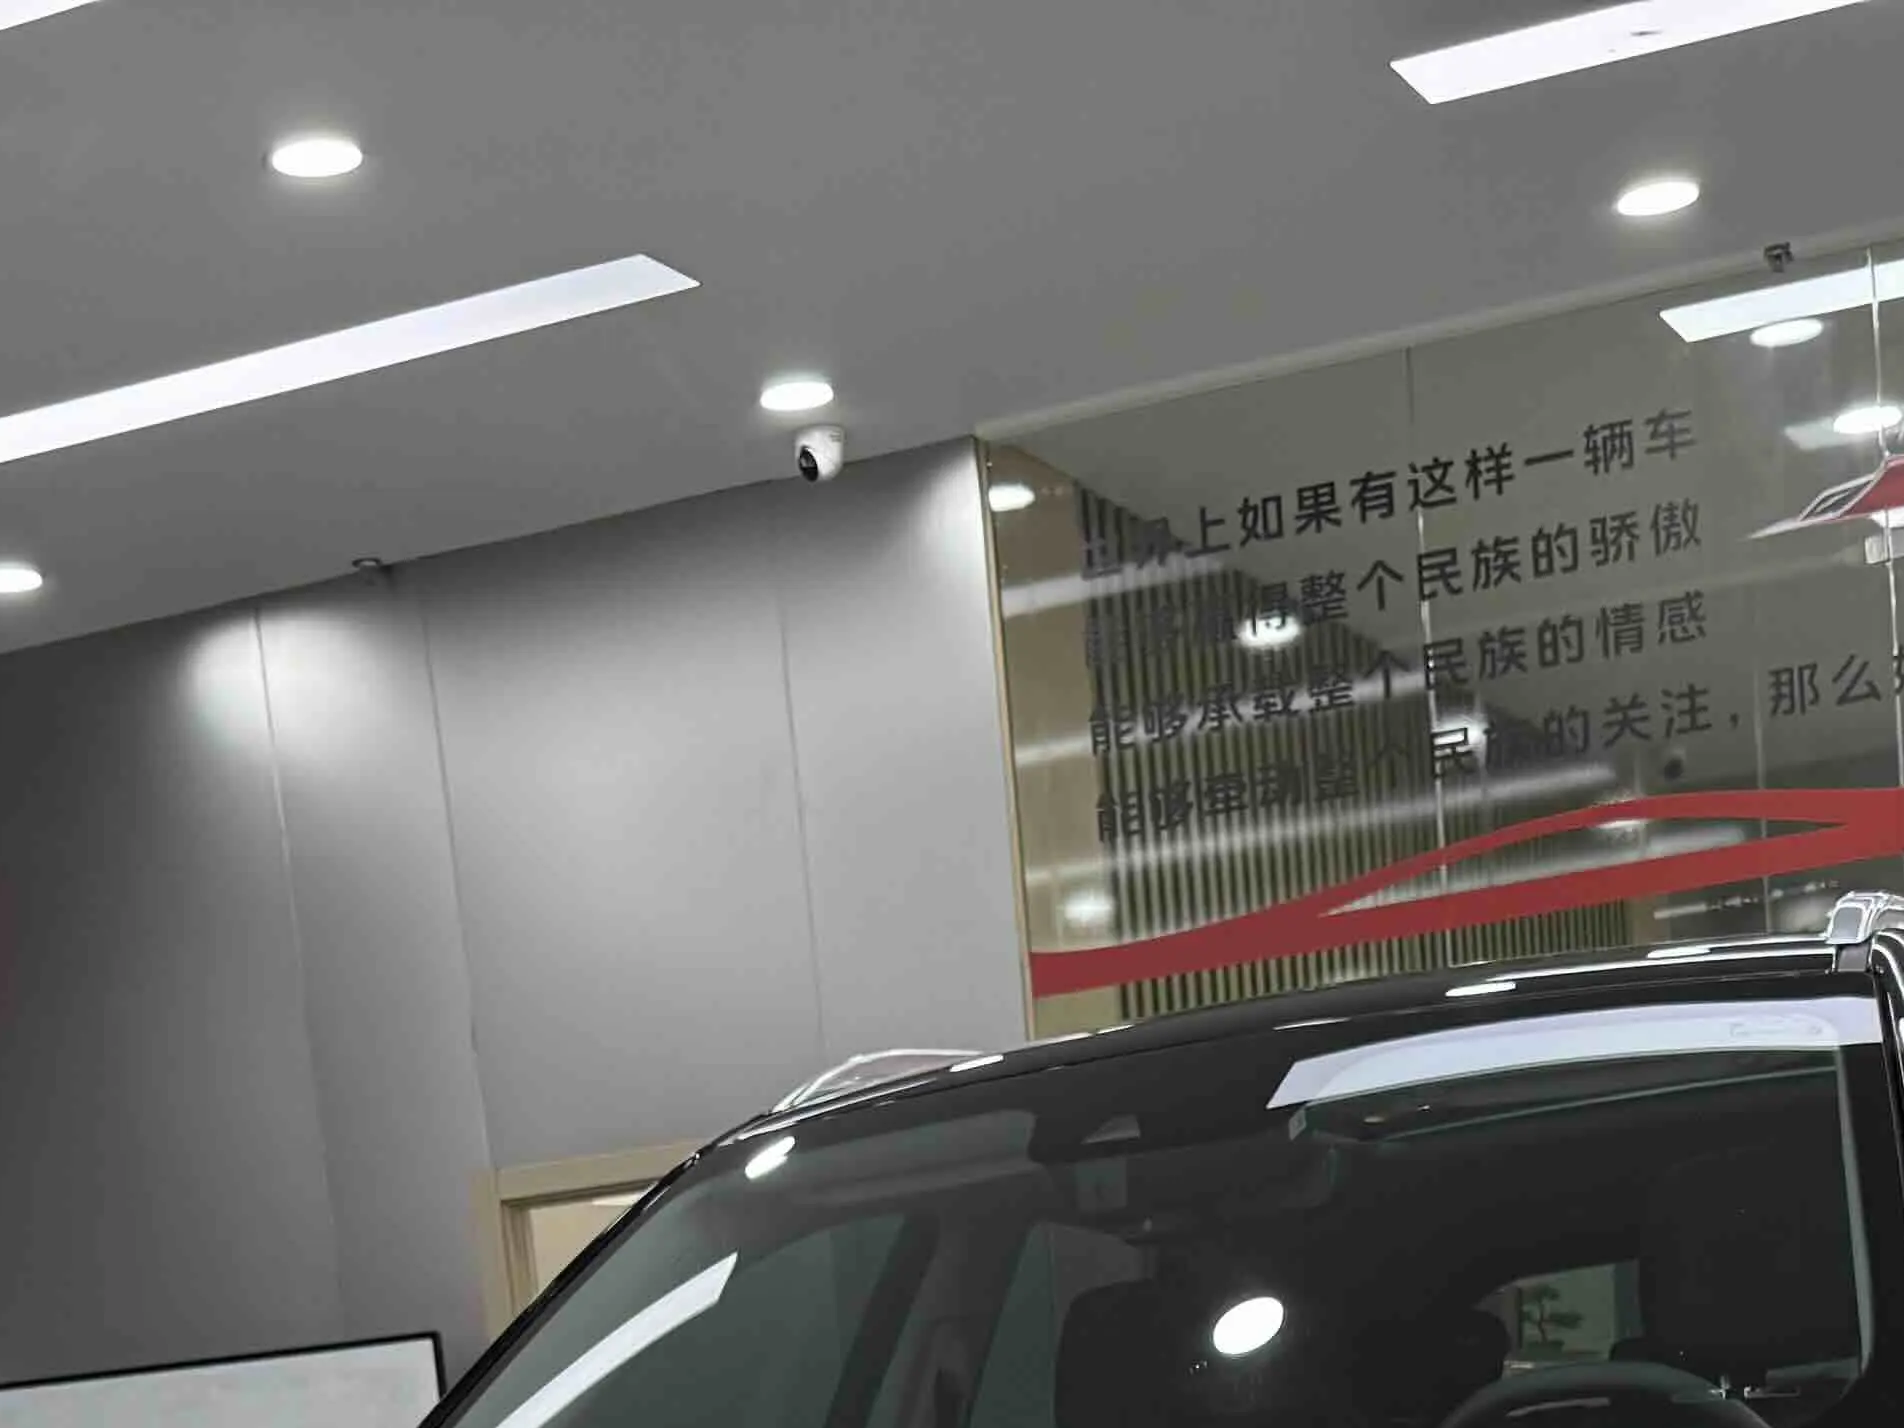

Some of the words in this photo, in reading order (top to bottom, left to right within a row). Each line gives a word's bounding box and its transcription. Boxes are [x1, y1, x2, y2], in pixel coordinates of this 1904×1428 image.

[1089, 590, 1708, 757] 能够承载整个民族的情感
